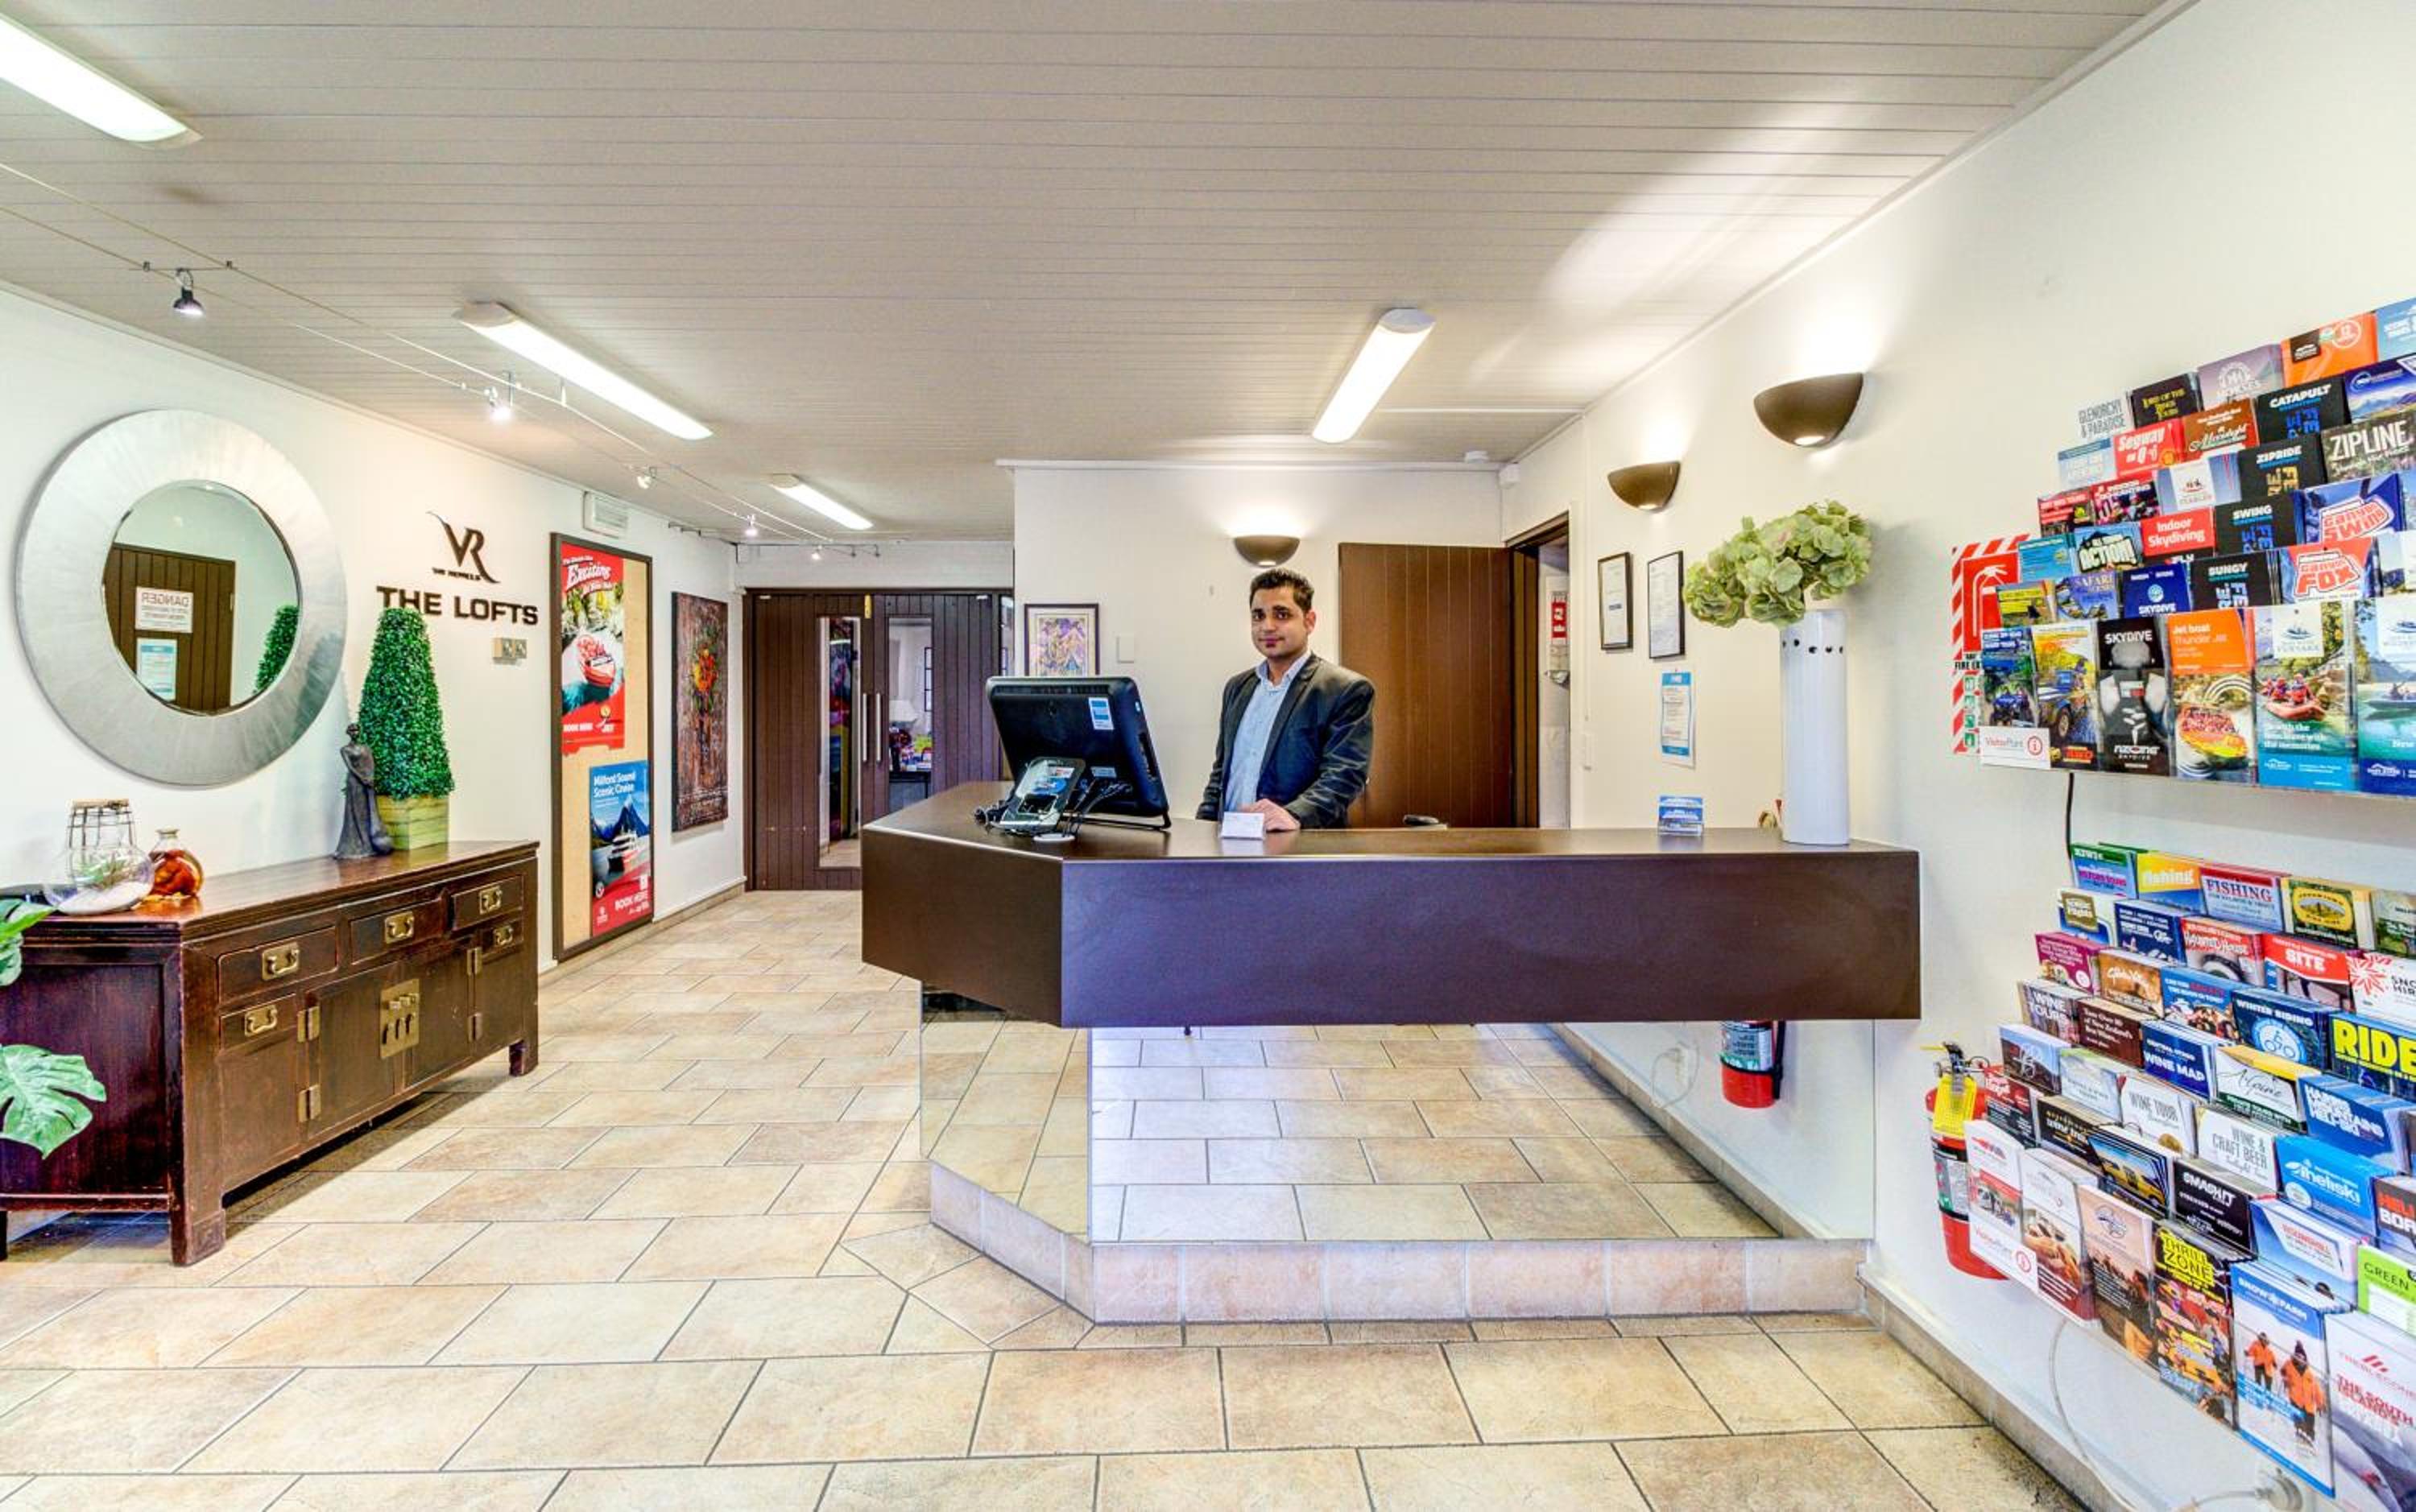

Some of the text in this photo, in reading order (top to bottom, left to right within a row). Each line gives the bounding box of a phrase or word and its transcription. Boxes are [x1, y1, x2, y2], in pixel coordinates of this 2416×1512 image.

[2269, 384, 2331, 407] CATAPULT
[2119, 427, 2166, 451] Segway
[2330, 419, 2408, 461] ZIPLINE
[2256, 445, 2302, 465] ZIPRIDE
[2232, 505, 2273, 519] SWING
[2157, 518, 2192, 531] Indoor
[2148, 529, 2205, 550] Skydiving
[566, 562, 611, 590] Exciting
[2207, 562, 2248, 576] BUNGY
[2297, 567, 2357, 595] FOX
[376, 586, 538, 626] THE LOFTS
[2139, 602, 2177, 614] SKYDIVE
[2104, 630, 2153, 644] SKYDIVE
[2174, 622, 2211, 634] Jet boat
[594, 770, 636, 787] Milford Sound
[594, 783, 635, 799] Scenic Cruise
[2206, 878, 2273, 903] FISHING
[2032, 989, 2067, 1013] WINE
[2275, 1010, 2314, 1027] RIDING
[2145, 1051, 2206, 1082] WINE MAP
[2129, 1093, 2152, 1112] WINE
[2231, 1126, 2256, 1146] WINE
[2212, 1134, 2268, 1169] CRAFT BEER
[2165, 1250, 2215, 1287] ZONE
[2364, 1262, 2410, 1291] GREEN
[2365, 1391, 2414, 1427] SOUTH
